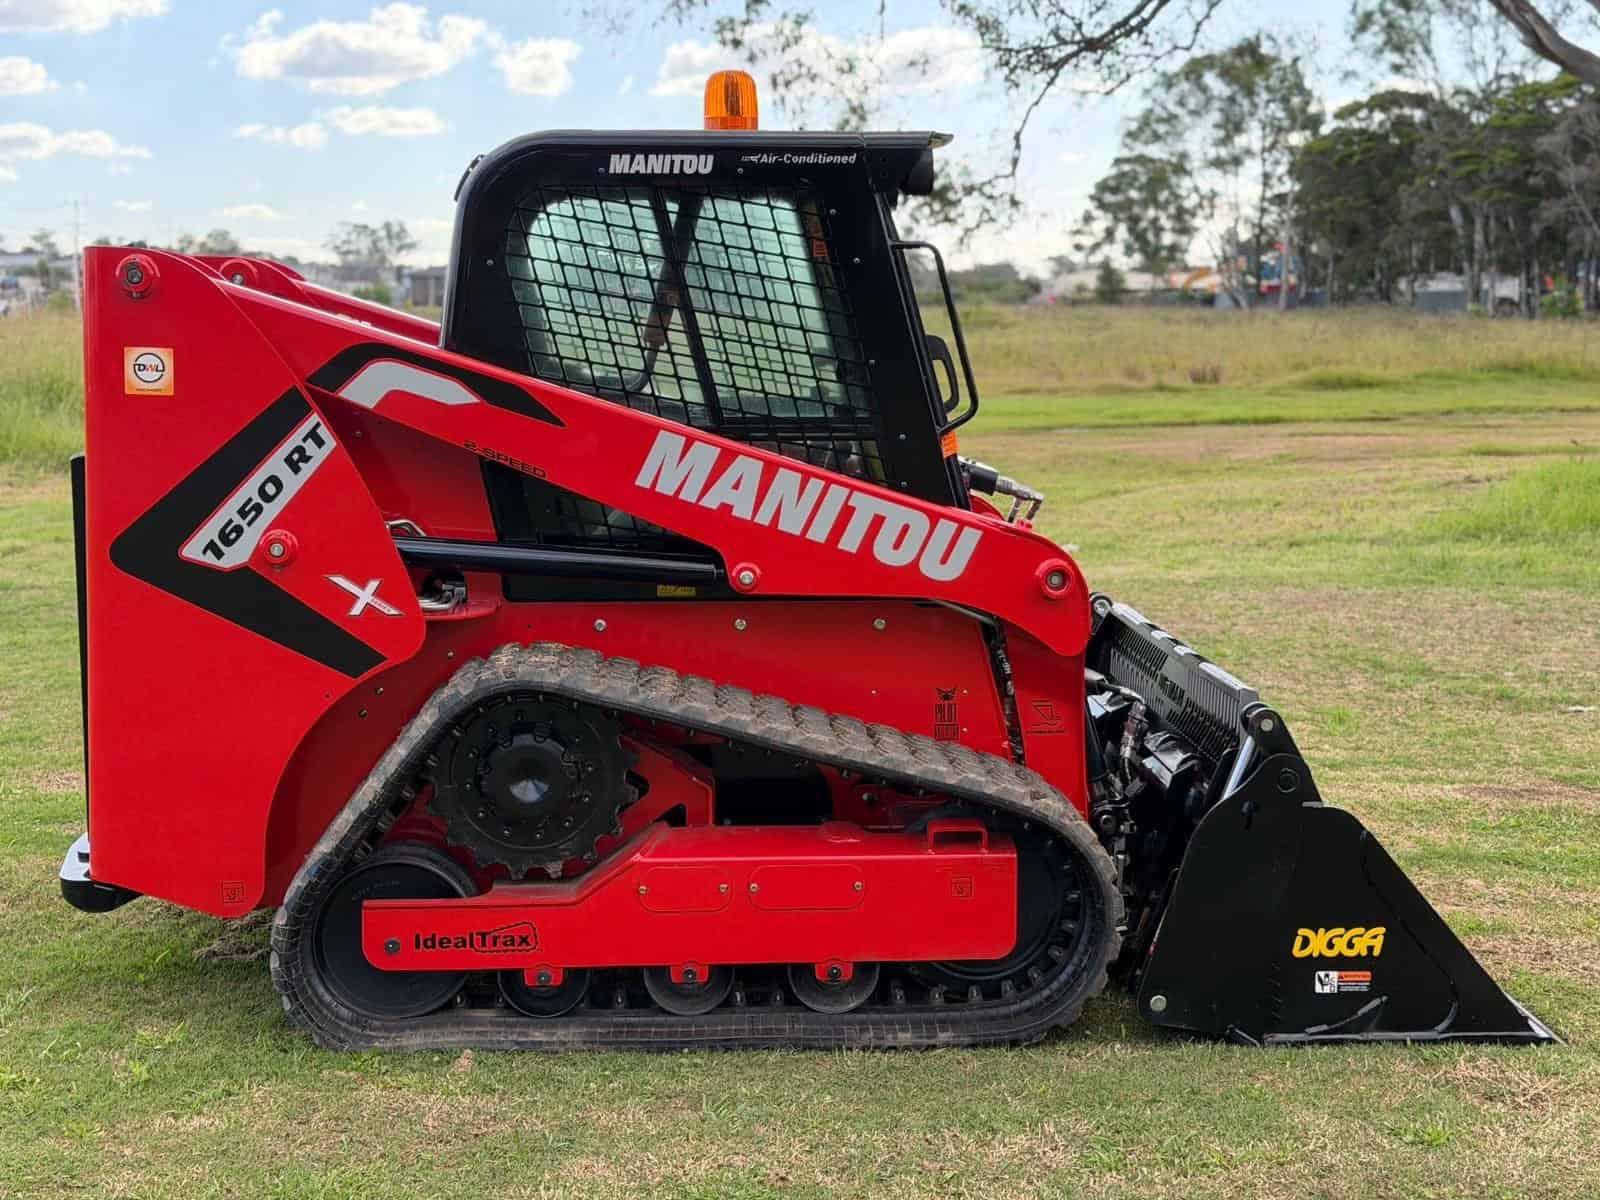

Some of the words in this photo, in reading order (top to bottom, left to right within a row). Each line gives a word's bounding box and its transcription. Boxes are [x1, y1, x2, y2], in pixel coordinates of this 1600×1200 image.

[608, 154, 714, 175] MANITOU
[760, 152, 857, 165] Air-Conditioned
[463, 439, 547, 480] 2-SPEED
[202, 474, 284, 561] 1650
[283, 421, 326, 476] RT
[634, 430, 984, 582] MANITOU
[414, 931, 532, 950] IdealTrax
[1292, 926, 1387, 958] DIGGA
